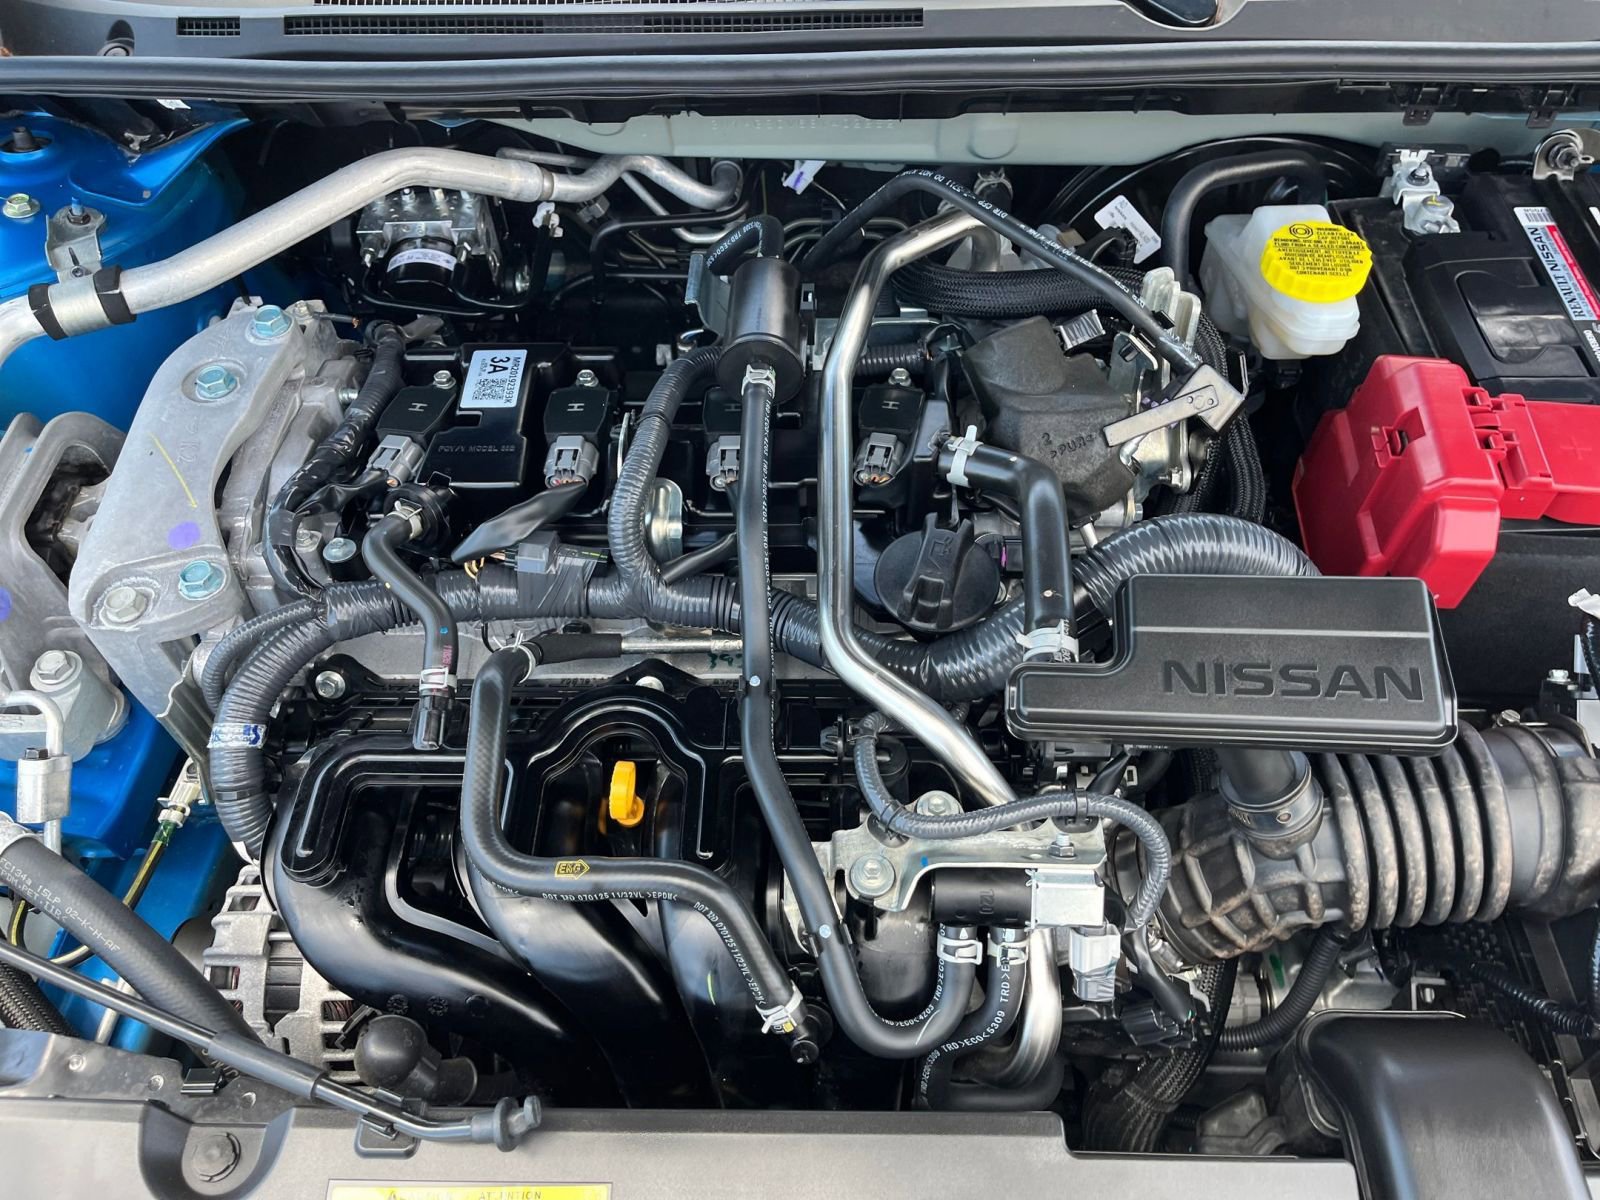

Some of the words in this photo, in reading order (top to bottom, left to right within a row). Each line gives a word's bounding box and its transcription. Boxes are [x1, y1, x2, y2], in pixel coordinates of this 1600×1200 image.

[1528, 227, 1560, 271] NISSAN
[1553, 274, 1586, 318] RENAULT
[488, 356, 510, 374] 3A
[1163, 659, 1424, 701] NISSAN
[647, 891, 678, 901] >EPDM<
[37, 885, 61, 904] 15LP
[65, 906, 120, 952] 02-K-H-AF
[693, 901, 708, 912] DOT
[716, 922, 736, 949] 070125
[941, 1010, 1006, 1052] TRD>ECO<5309
